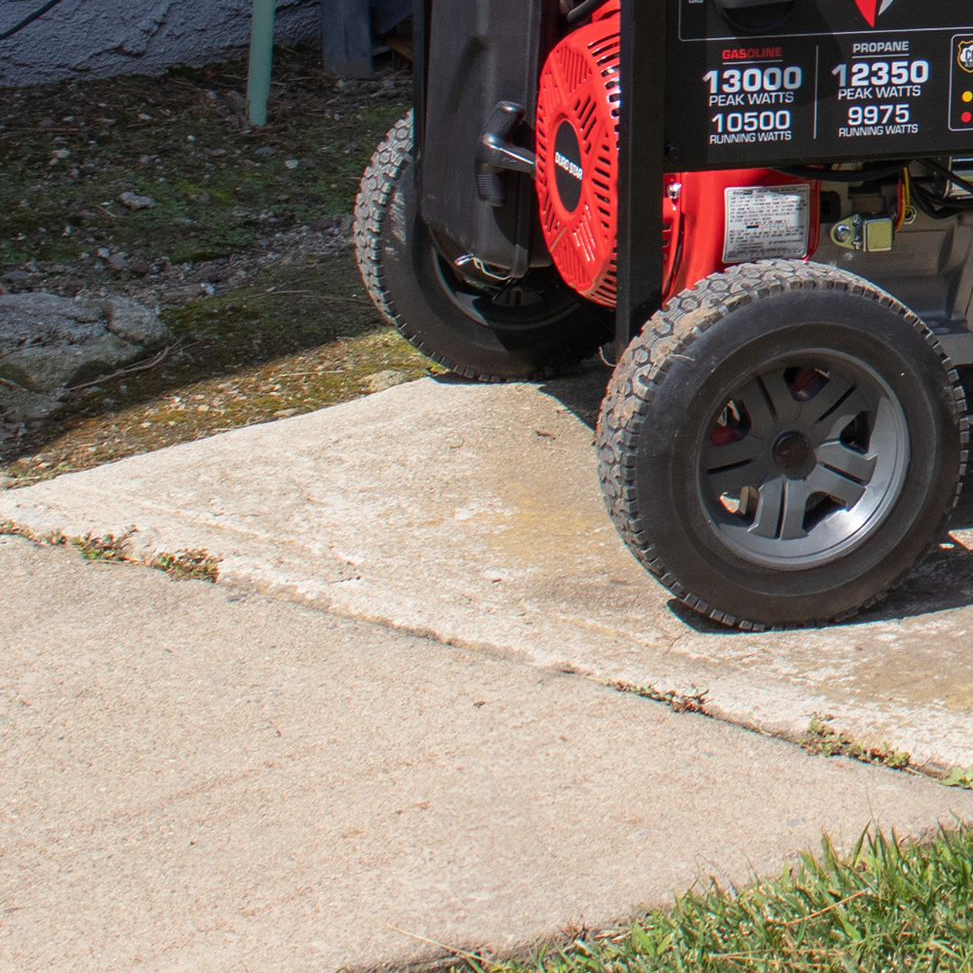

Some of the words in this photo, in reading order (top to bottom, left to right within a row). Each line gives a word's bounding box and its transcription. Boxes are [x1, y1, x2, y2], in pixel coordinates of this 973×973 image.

[721, 46, 783, 60] GASOLINE
[852, 40, 910, 54] PROPANE
[702, 65, 803, 94] 13000
[831, 59, 929, 88] 12350
[709, 94, 743, 107] PEAK
[745, 91, 795, 105] WATTS
[837, 87, 872, 101] PEAK
[873, 84, 922, 99] WATTS
[711, 110, 791, 134] 10500
[847, 103, 910, 126] 9975
[709, 134, 756, 145] RUNNING
[757, 130, 792, 142] WATTS
[838, 126, 886, 138] RUNNING
[887, 124, 919, 136] WATTS
